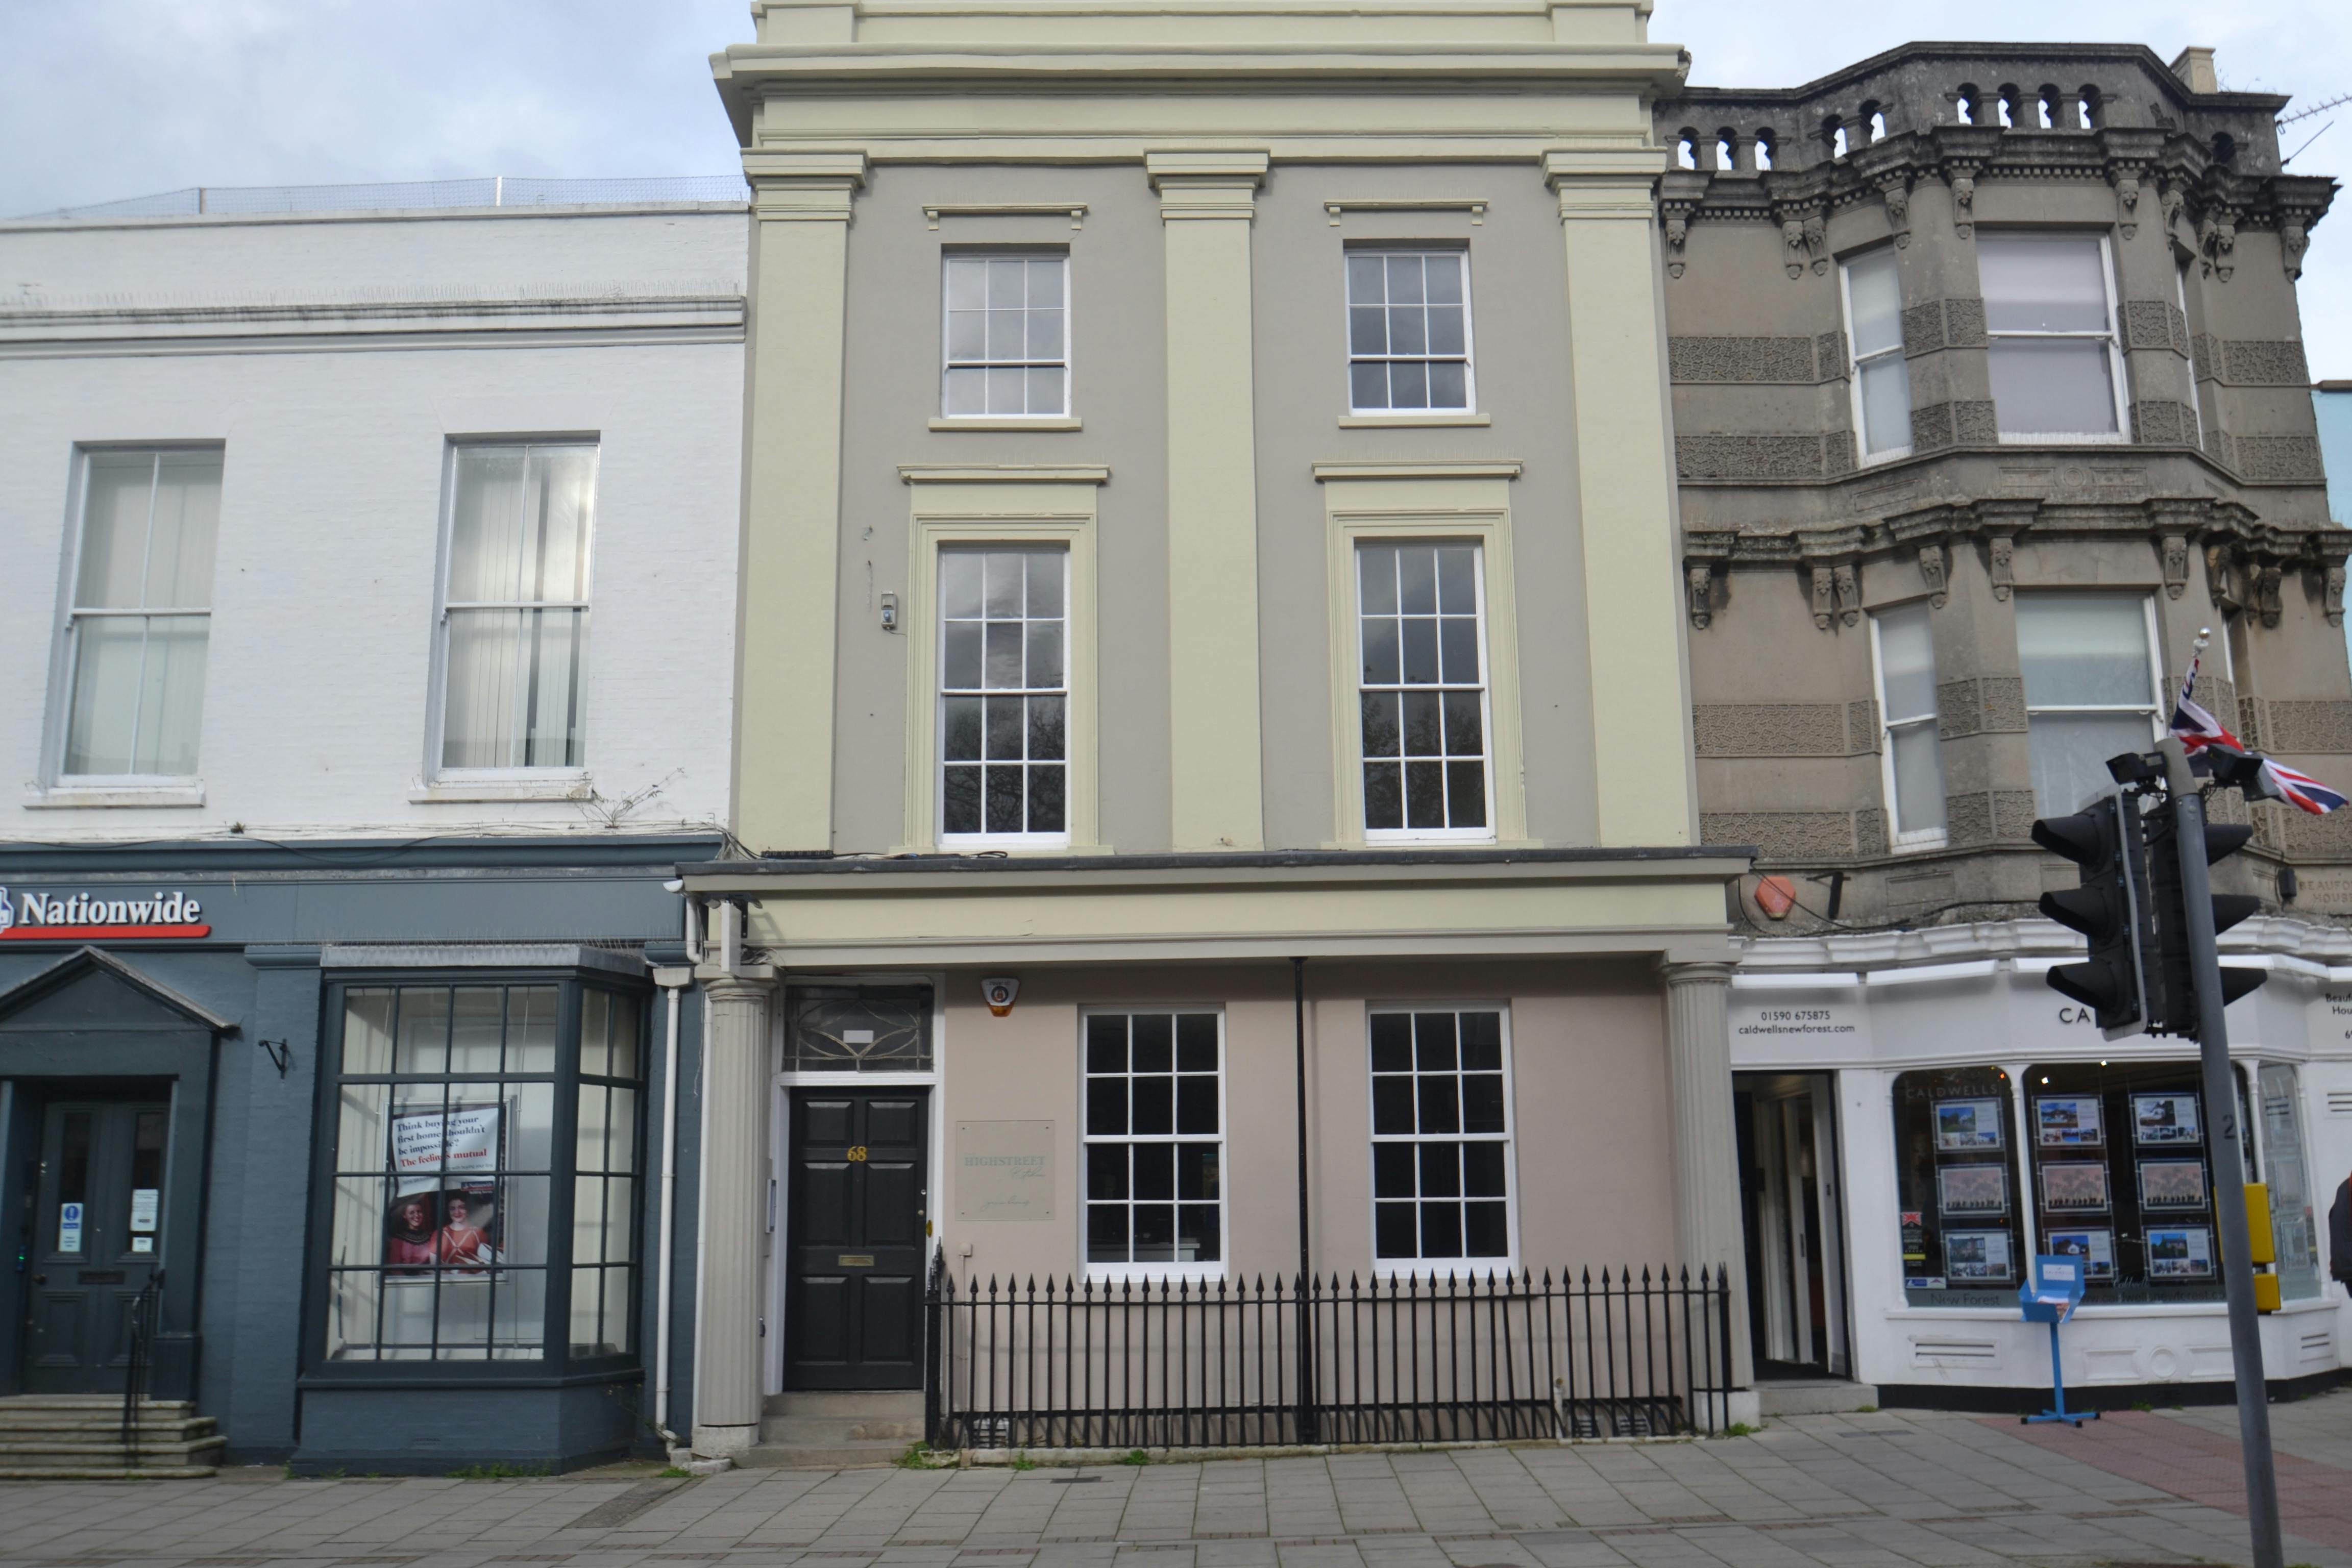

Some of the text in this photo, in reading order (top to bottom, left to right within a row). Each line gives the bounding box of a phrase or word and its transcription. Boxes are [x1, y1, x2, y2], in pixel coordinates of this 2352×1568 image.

[2298, 880, 2352, 891] BEAUFO
[19, 891, 201, 924] Nationwide
[1761, 1010, 1831, 1021] 01590 675875
[1738, 1024, 1855, 1034] caldwellsnewforest.com
[1906, 1084, 1998, 1098] CALDWELLS
[397, 1116, 479, 1132] Think buyg your
[2222, 1114, 2237, 1140] 2
[398, 1134, 414, 1144] first
[416, 1131, 442, 1141] home
[410, 1139, 459, 1154] impossie?
[847, 1146, 867, 1161] 68
[401, 1148, 487, 1167] The feelins mutual
[964, 1156, 1046, 1166] HIGHSTREET
[1931, 1293, 2002, 1306] New Forest
